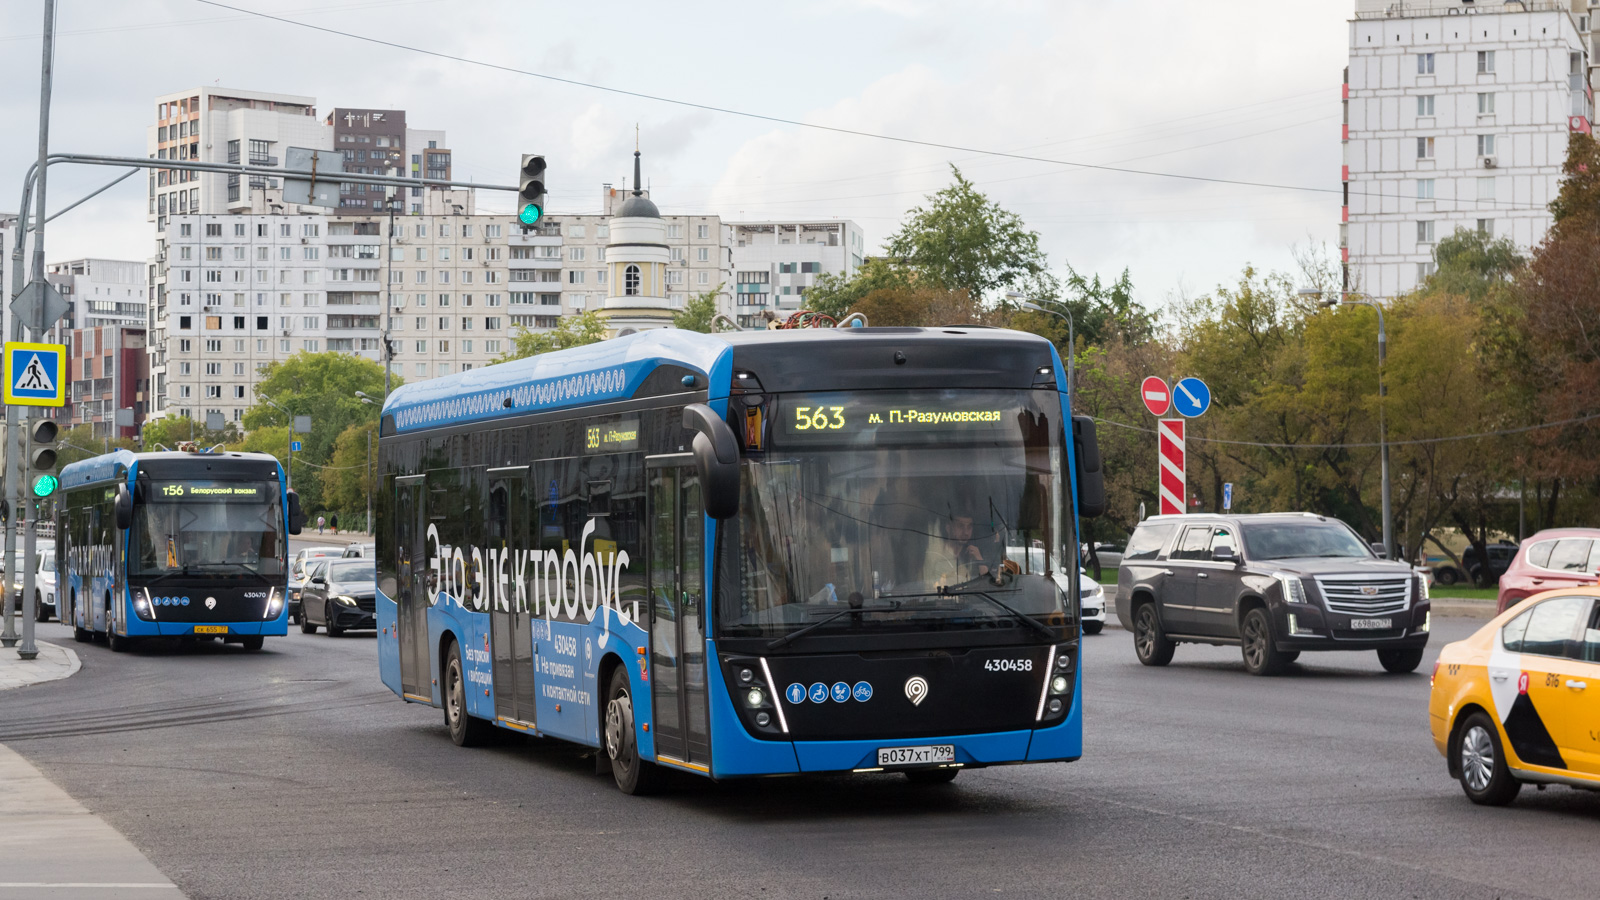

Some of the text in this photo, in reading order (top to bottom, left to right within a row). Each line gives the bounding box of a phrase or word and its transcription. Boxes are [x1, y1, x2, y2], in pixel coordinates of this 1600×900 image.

[795, 406, 845, 430] 563
[869, 413, 884, 424] м.
[587, 428, 599, 448] 563
[190, 487, 232, 495] Белорусский
[427, 523, 465, 608] Это
[465, 643, 474, 661] Без
[474, 649, 490, 665] тряски
[554, 634, 577, 657] 430458
[541, 656, 575, 680] Не привязан
[984, 658, 1033, 673] 430458
[1545, 673, 1560, 688] 816
[546, 684, 577, 703] контактной
[577, 690, 591, 706] сети
[882, 746, 952, 763] В037ХТ 799
